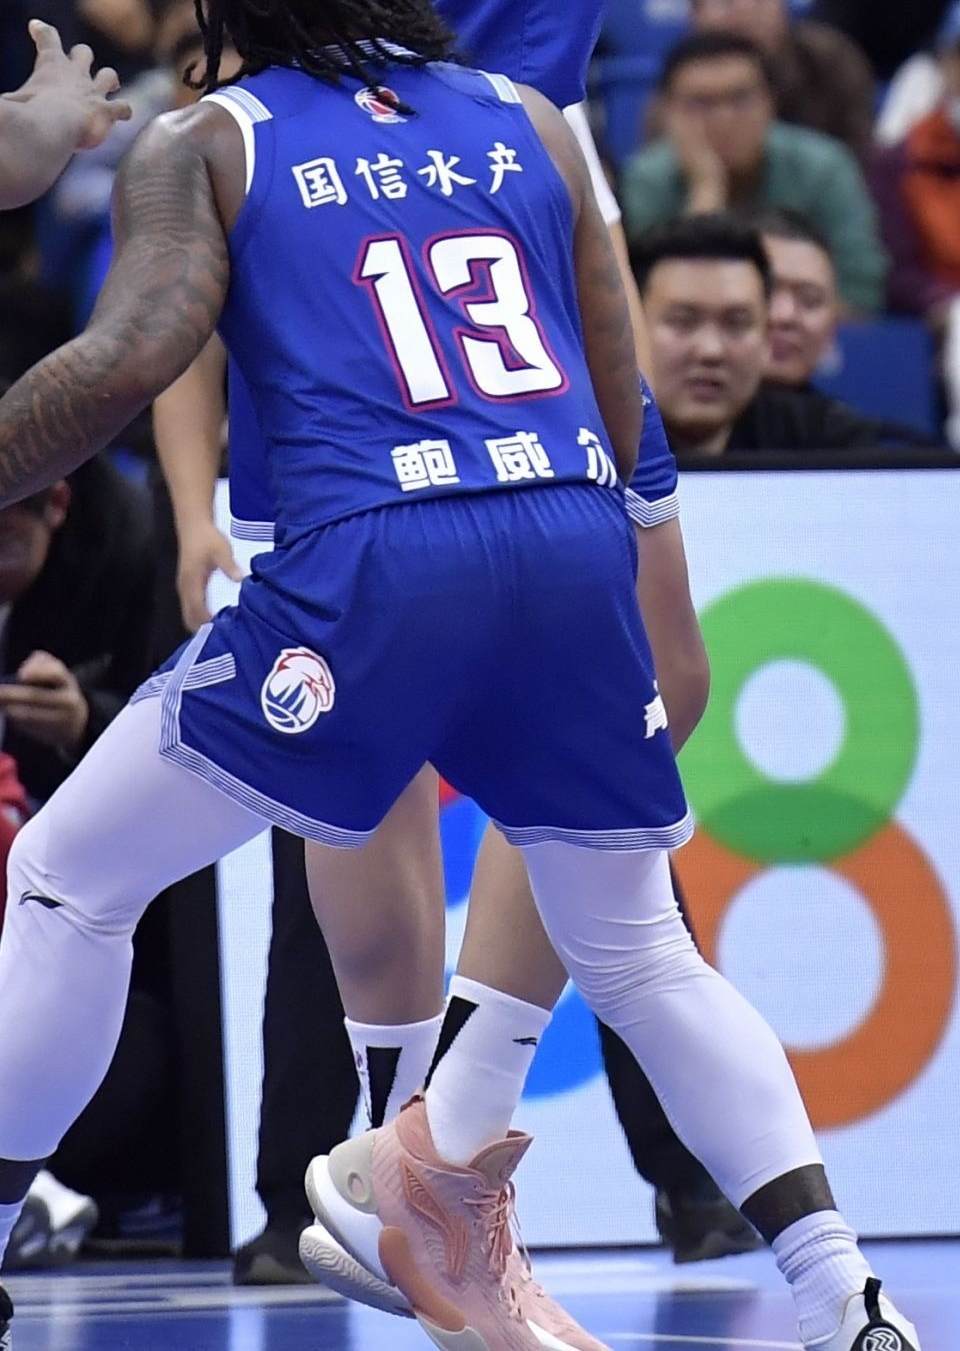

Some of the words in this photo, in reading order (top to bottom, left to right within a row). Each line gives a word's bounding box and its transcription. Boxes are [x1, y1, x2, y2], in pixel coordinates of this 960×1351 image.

[291, 141, 524, 210] 国信水产
[353, 227, 570, 413] 13
